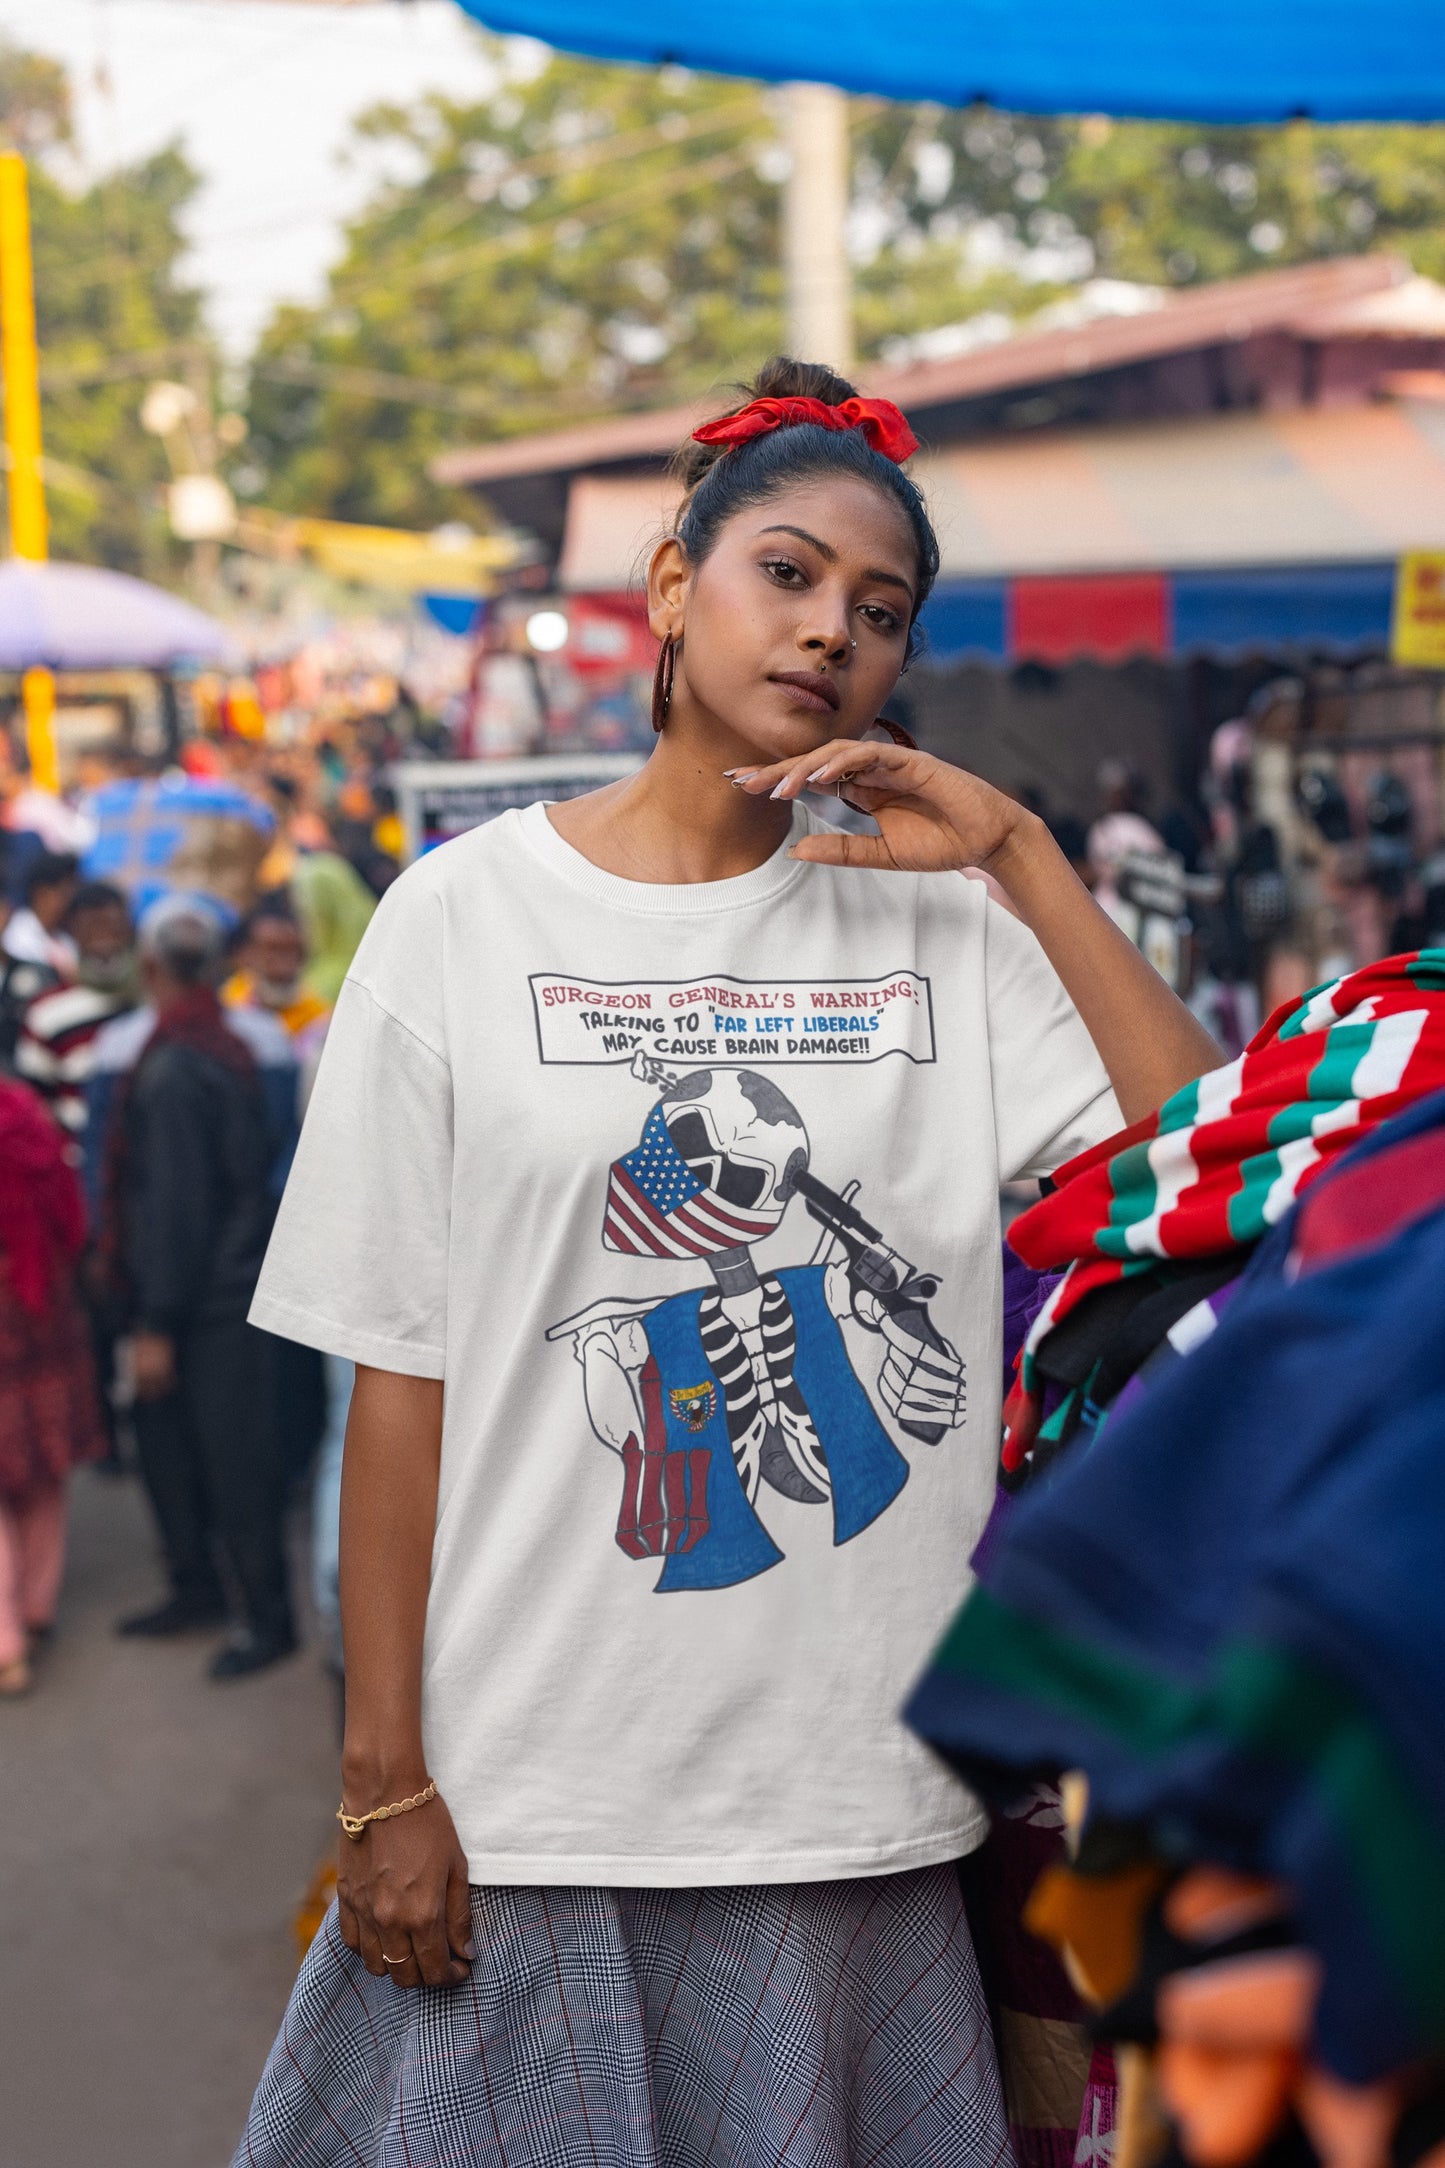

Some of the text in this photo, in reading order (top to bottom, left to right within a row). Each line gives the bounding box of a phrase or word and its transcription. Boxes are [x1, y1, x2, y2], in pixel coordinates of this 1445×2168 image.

[542, 986, 652, 1009] SURGEON
[668, 986, 796, 1008] GENERAL'S
[579, 1011, 665, 1033] TALKING
[673, 1012, 699, 1033] TO
[755, 1016, 794, 1033] LEFT
[602, 1033, 870, 1055] MAY CAUSE BRAIN DAMAGE!!
